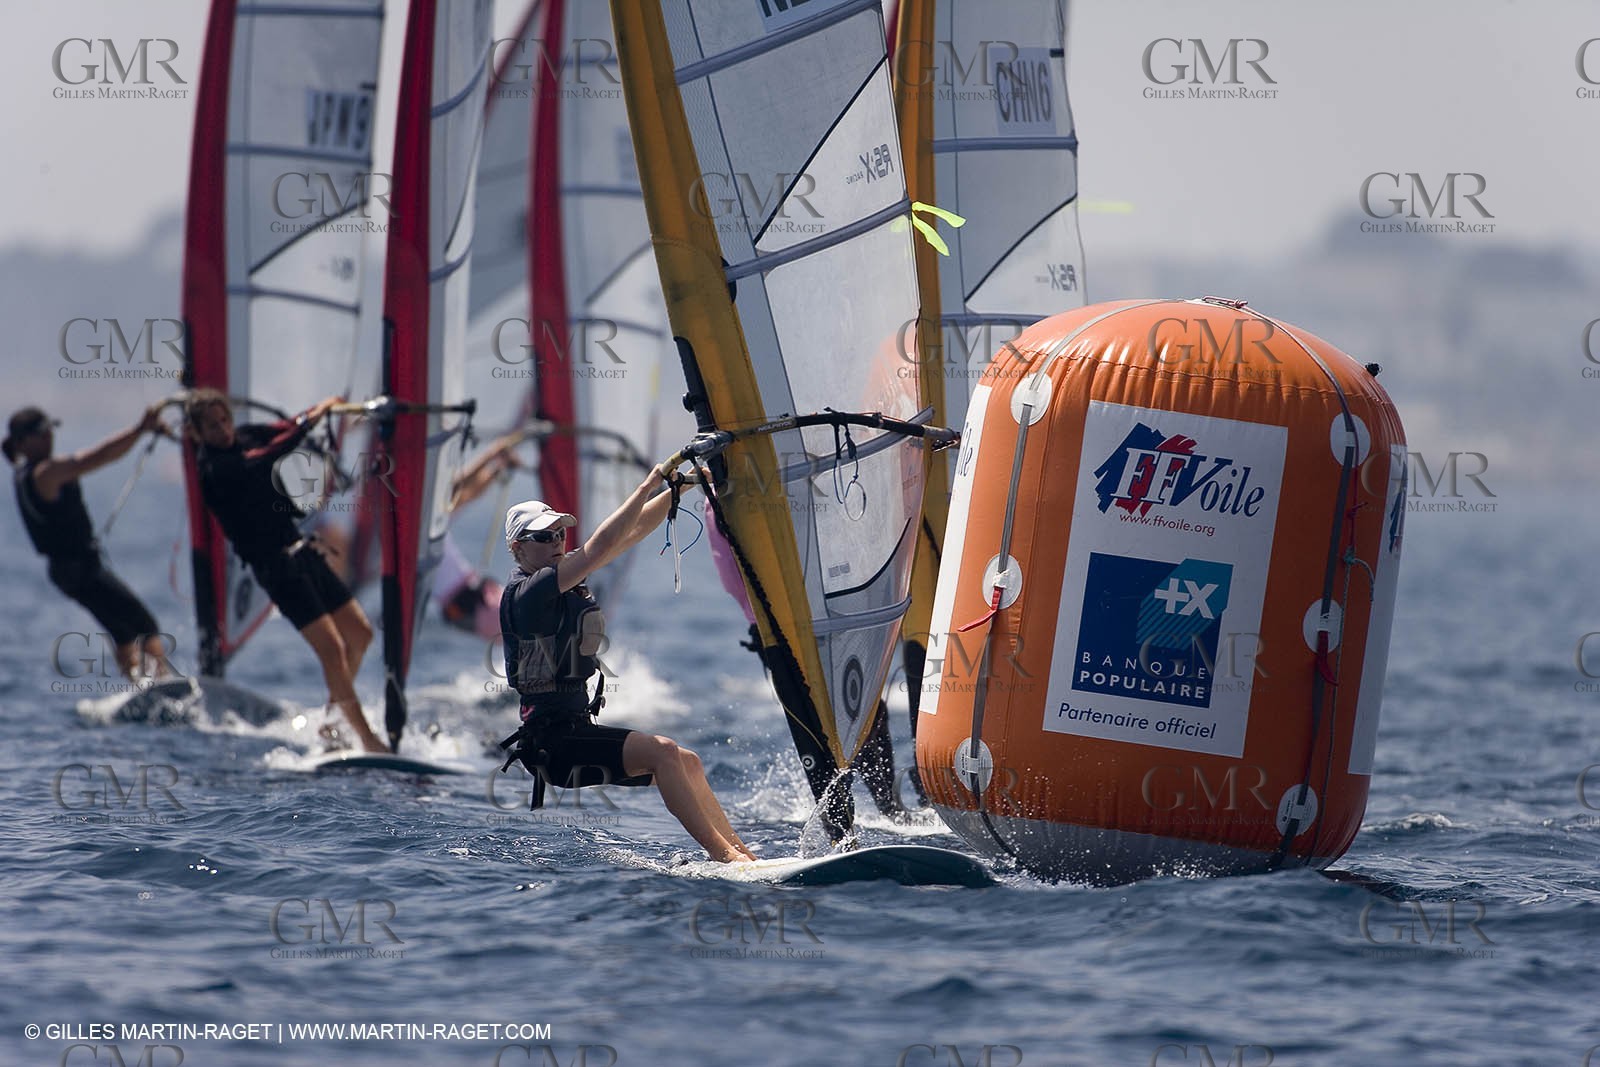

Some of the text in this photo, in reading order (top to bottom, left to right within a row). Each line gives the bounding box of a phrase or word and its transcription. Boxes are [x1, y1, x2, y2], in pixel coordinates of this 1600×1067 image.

[1119, 514, 1216, 537] www.ffvoile.org
[1082, 652, 1206, 679] BANQUE
[1079, 670, 1205, 699] POPULAIRE
[1058, 702, 1217, 739] Partenaire officiel
